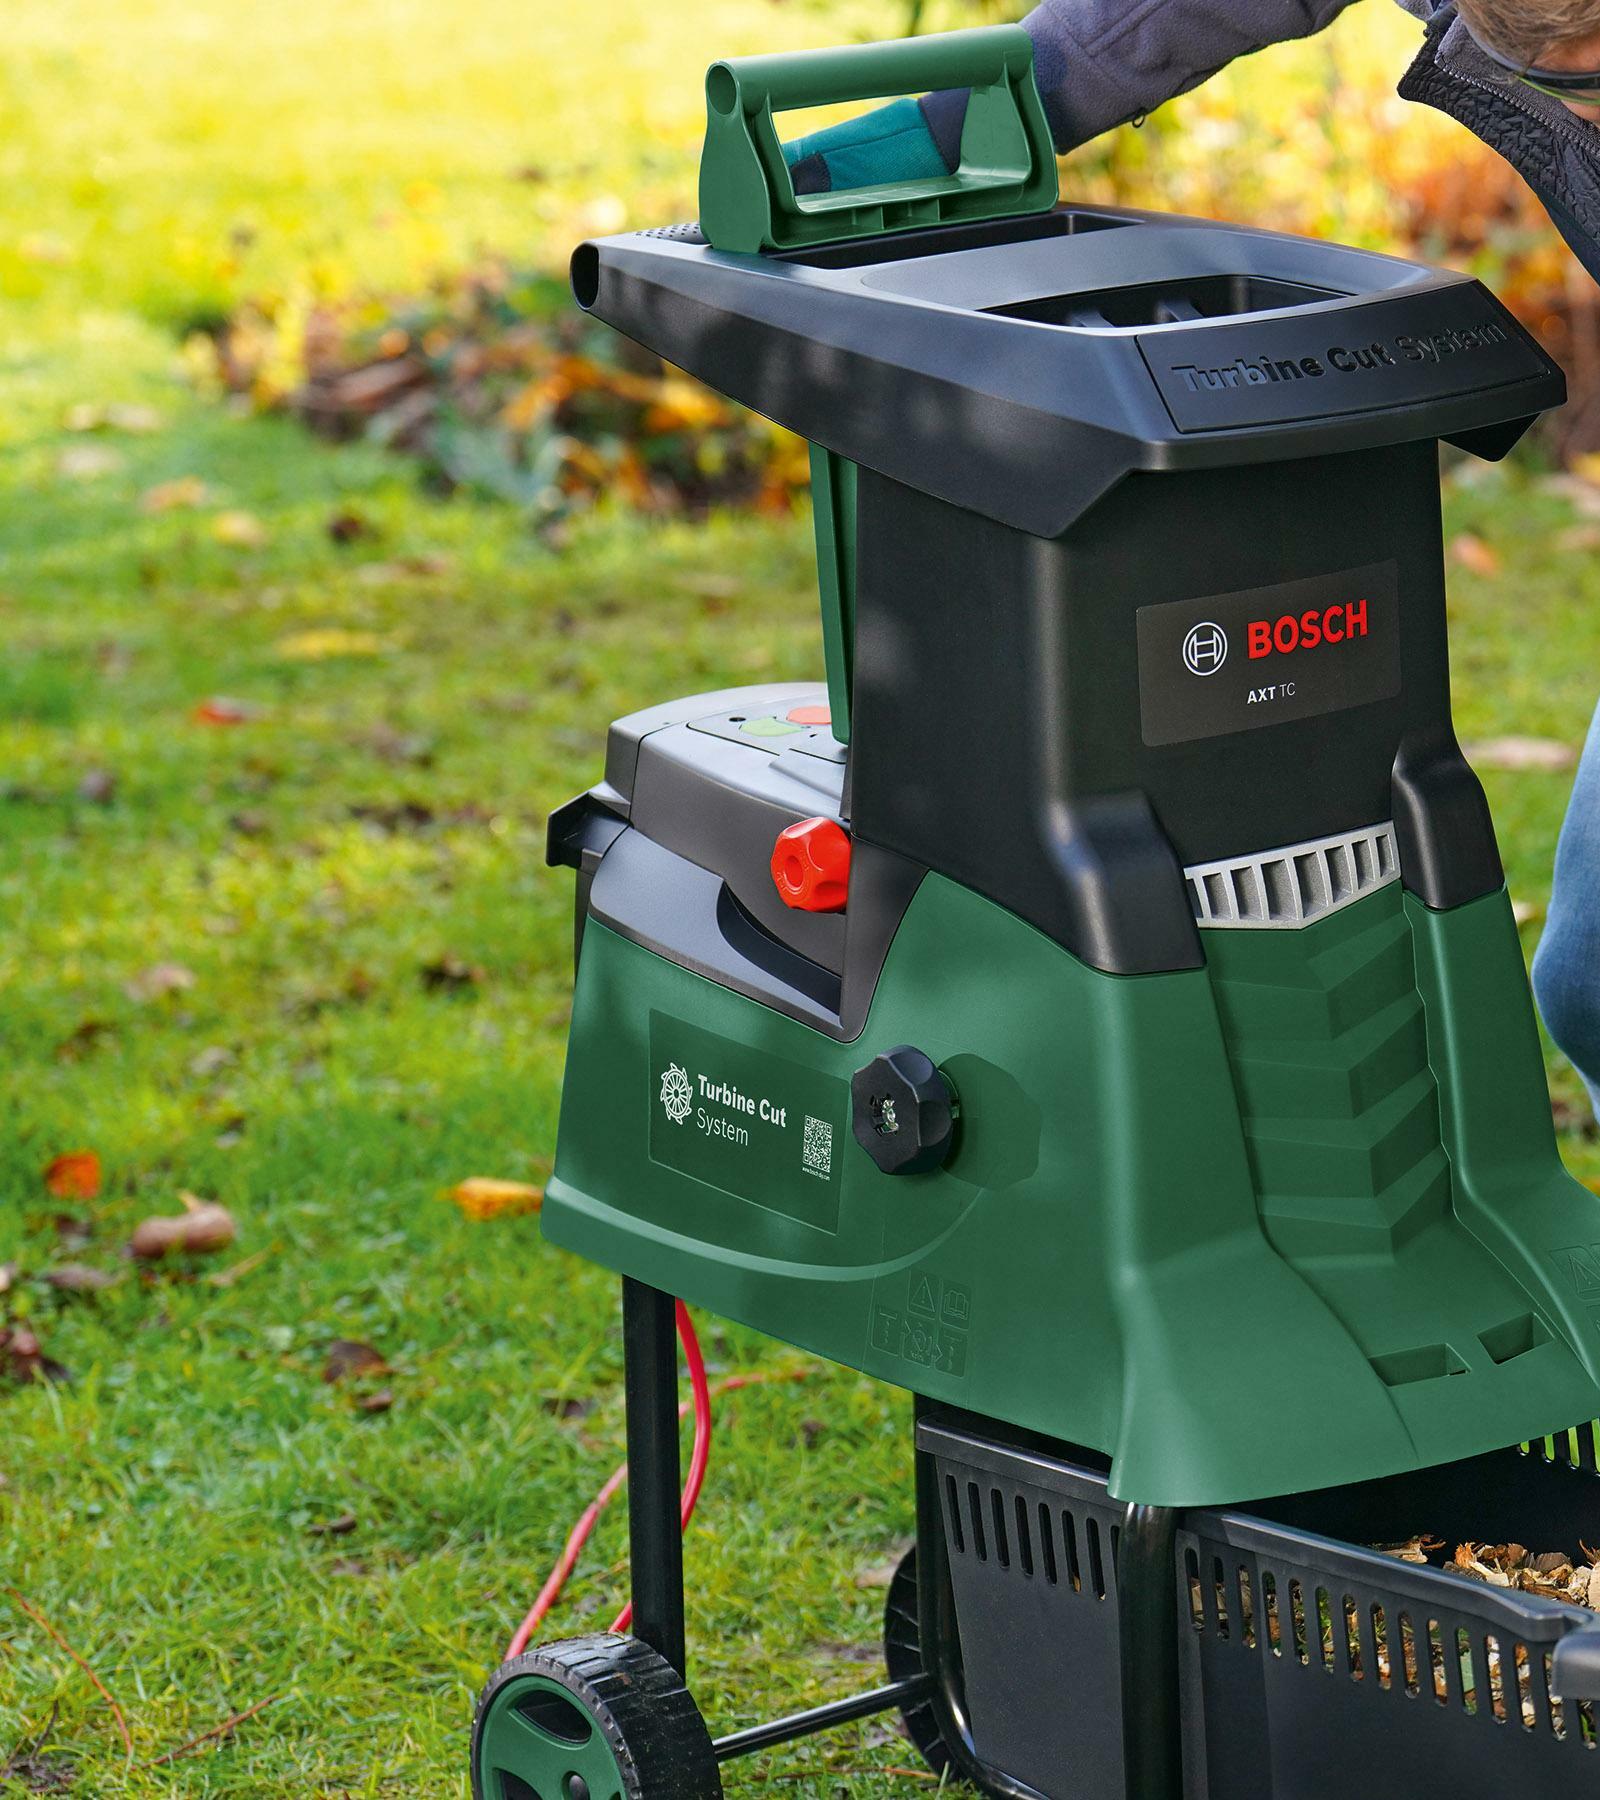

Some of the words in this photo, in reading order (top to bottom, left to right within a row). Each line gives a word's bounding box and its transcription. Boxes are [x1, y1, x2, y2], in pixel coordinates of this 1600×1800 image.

[1171, 354, 1325, 393] Turbine
[1326, 343, 1395, 372] Cut
[1395, 321, 1508, 363] System
[1247, 599, 1368, 659] BOSCH
[1246, 686, 1276, 705] AXT
[1279, 682, 1296, 698] TC
[696, 1107, 749, 1147] System
[697, 1073, 756, 1116] Turbine
[759, 1098, 787, 1128] Cut
